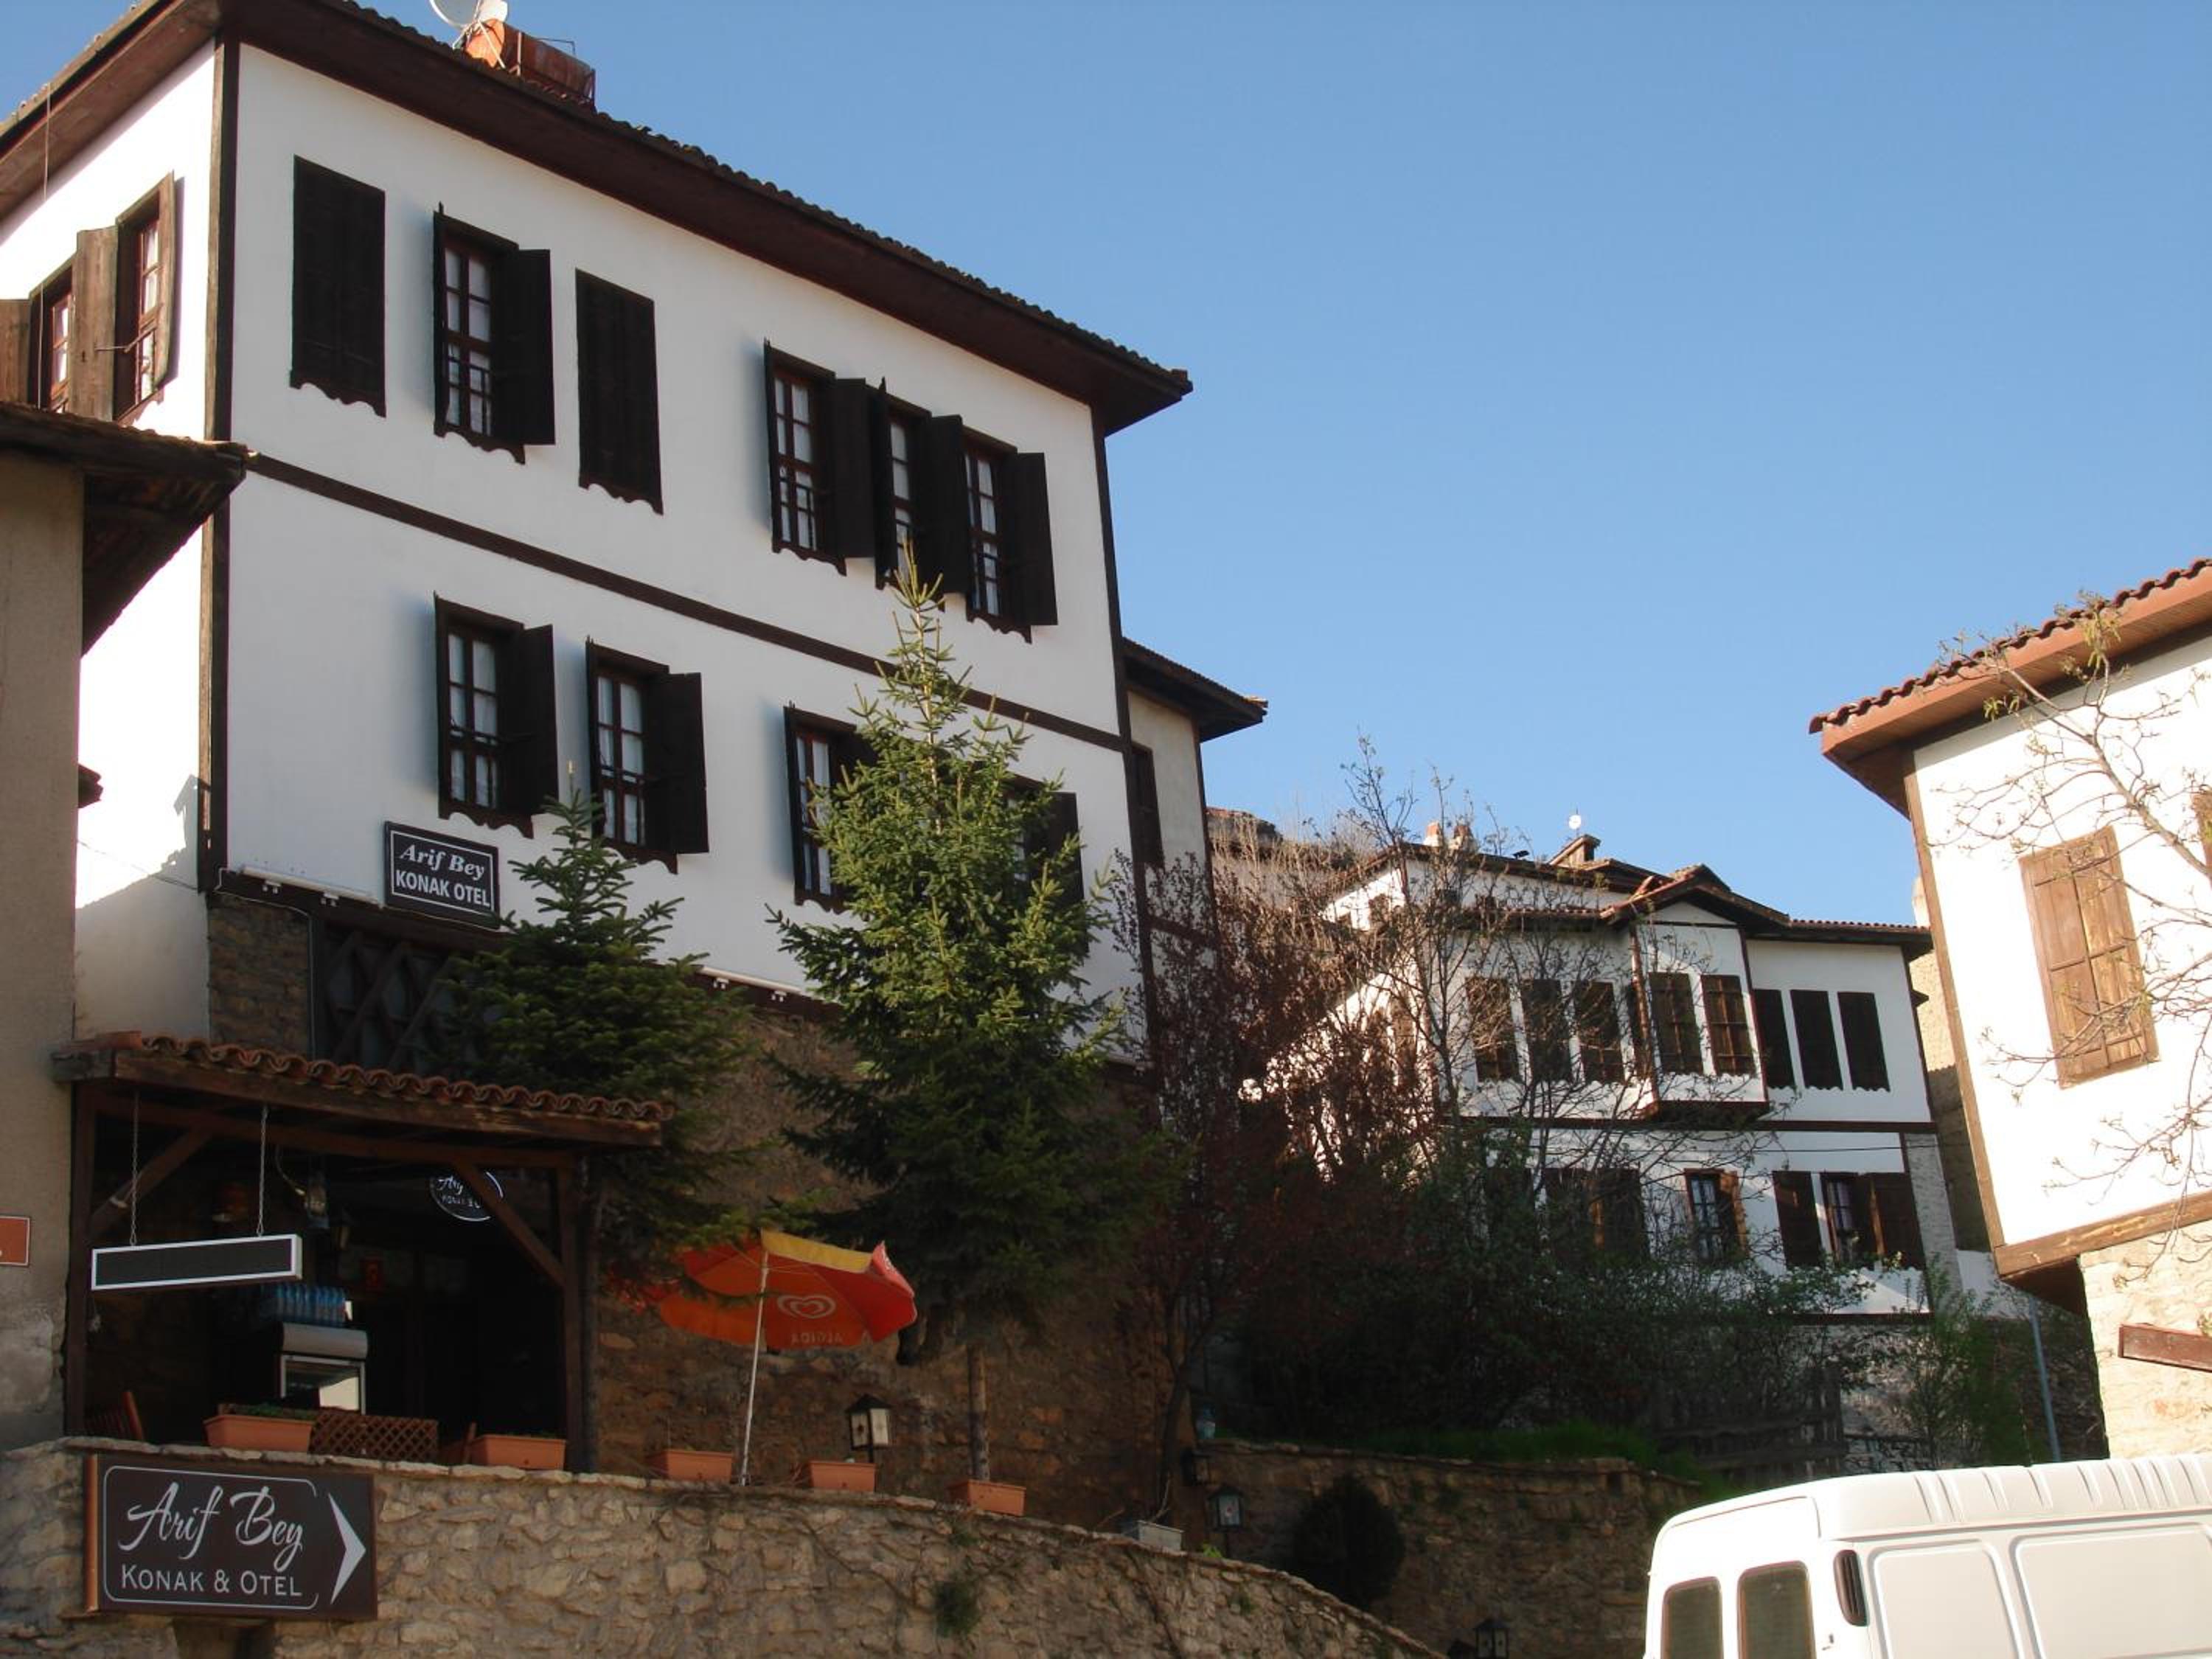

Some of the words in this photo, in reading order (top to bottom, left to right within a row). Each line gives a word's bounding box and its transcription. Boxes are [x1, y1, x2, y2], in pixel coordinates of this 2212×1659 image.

[400, 844, 446, 871] Arif
[448, 855, 485, 880] Bey
[396, 869, 450, 897] KONAK
[453, 883, 490, 907] OTEL
[118, 1482, 223, 1559] Arif
[229, 1486, 303, 1572] Bey
[121, 1564, 204, 1592] KONAK
[214, 1570, 229, 1593] &
[240, 1571, 303, 1597] OTEL
